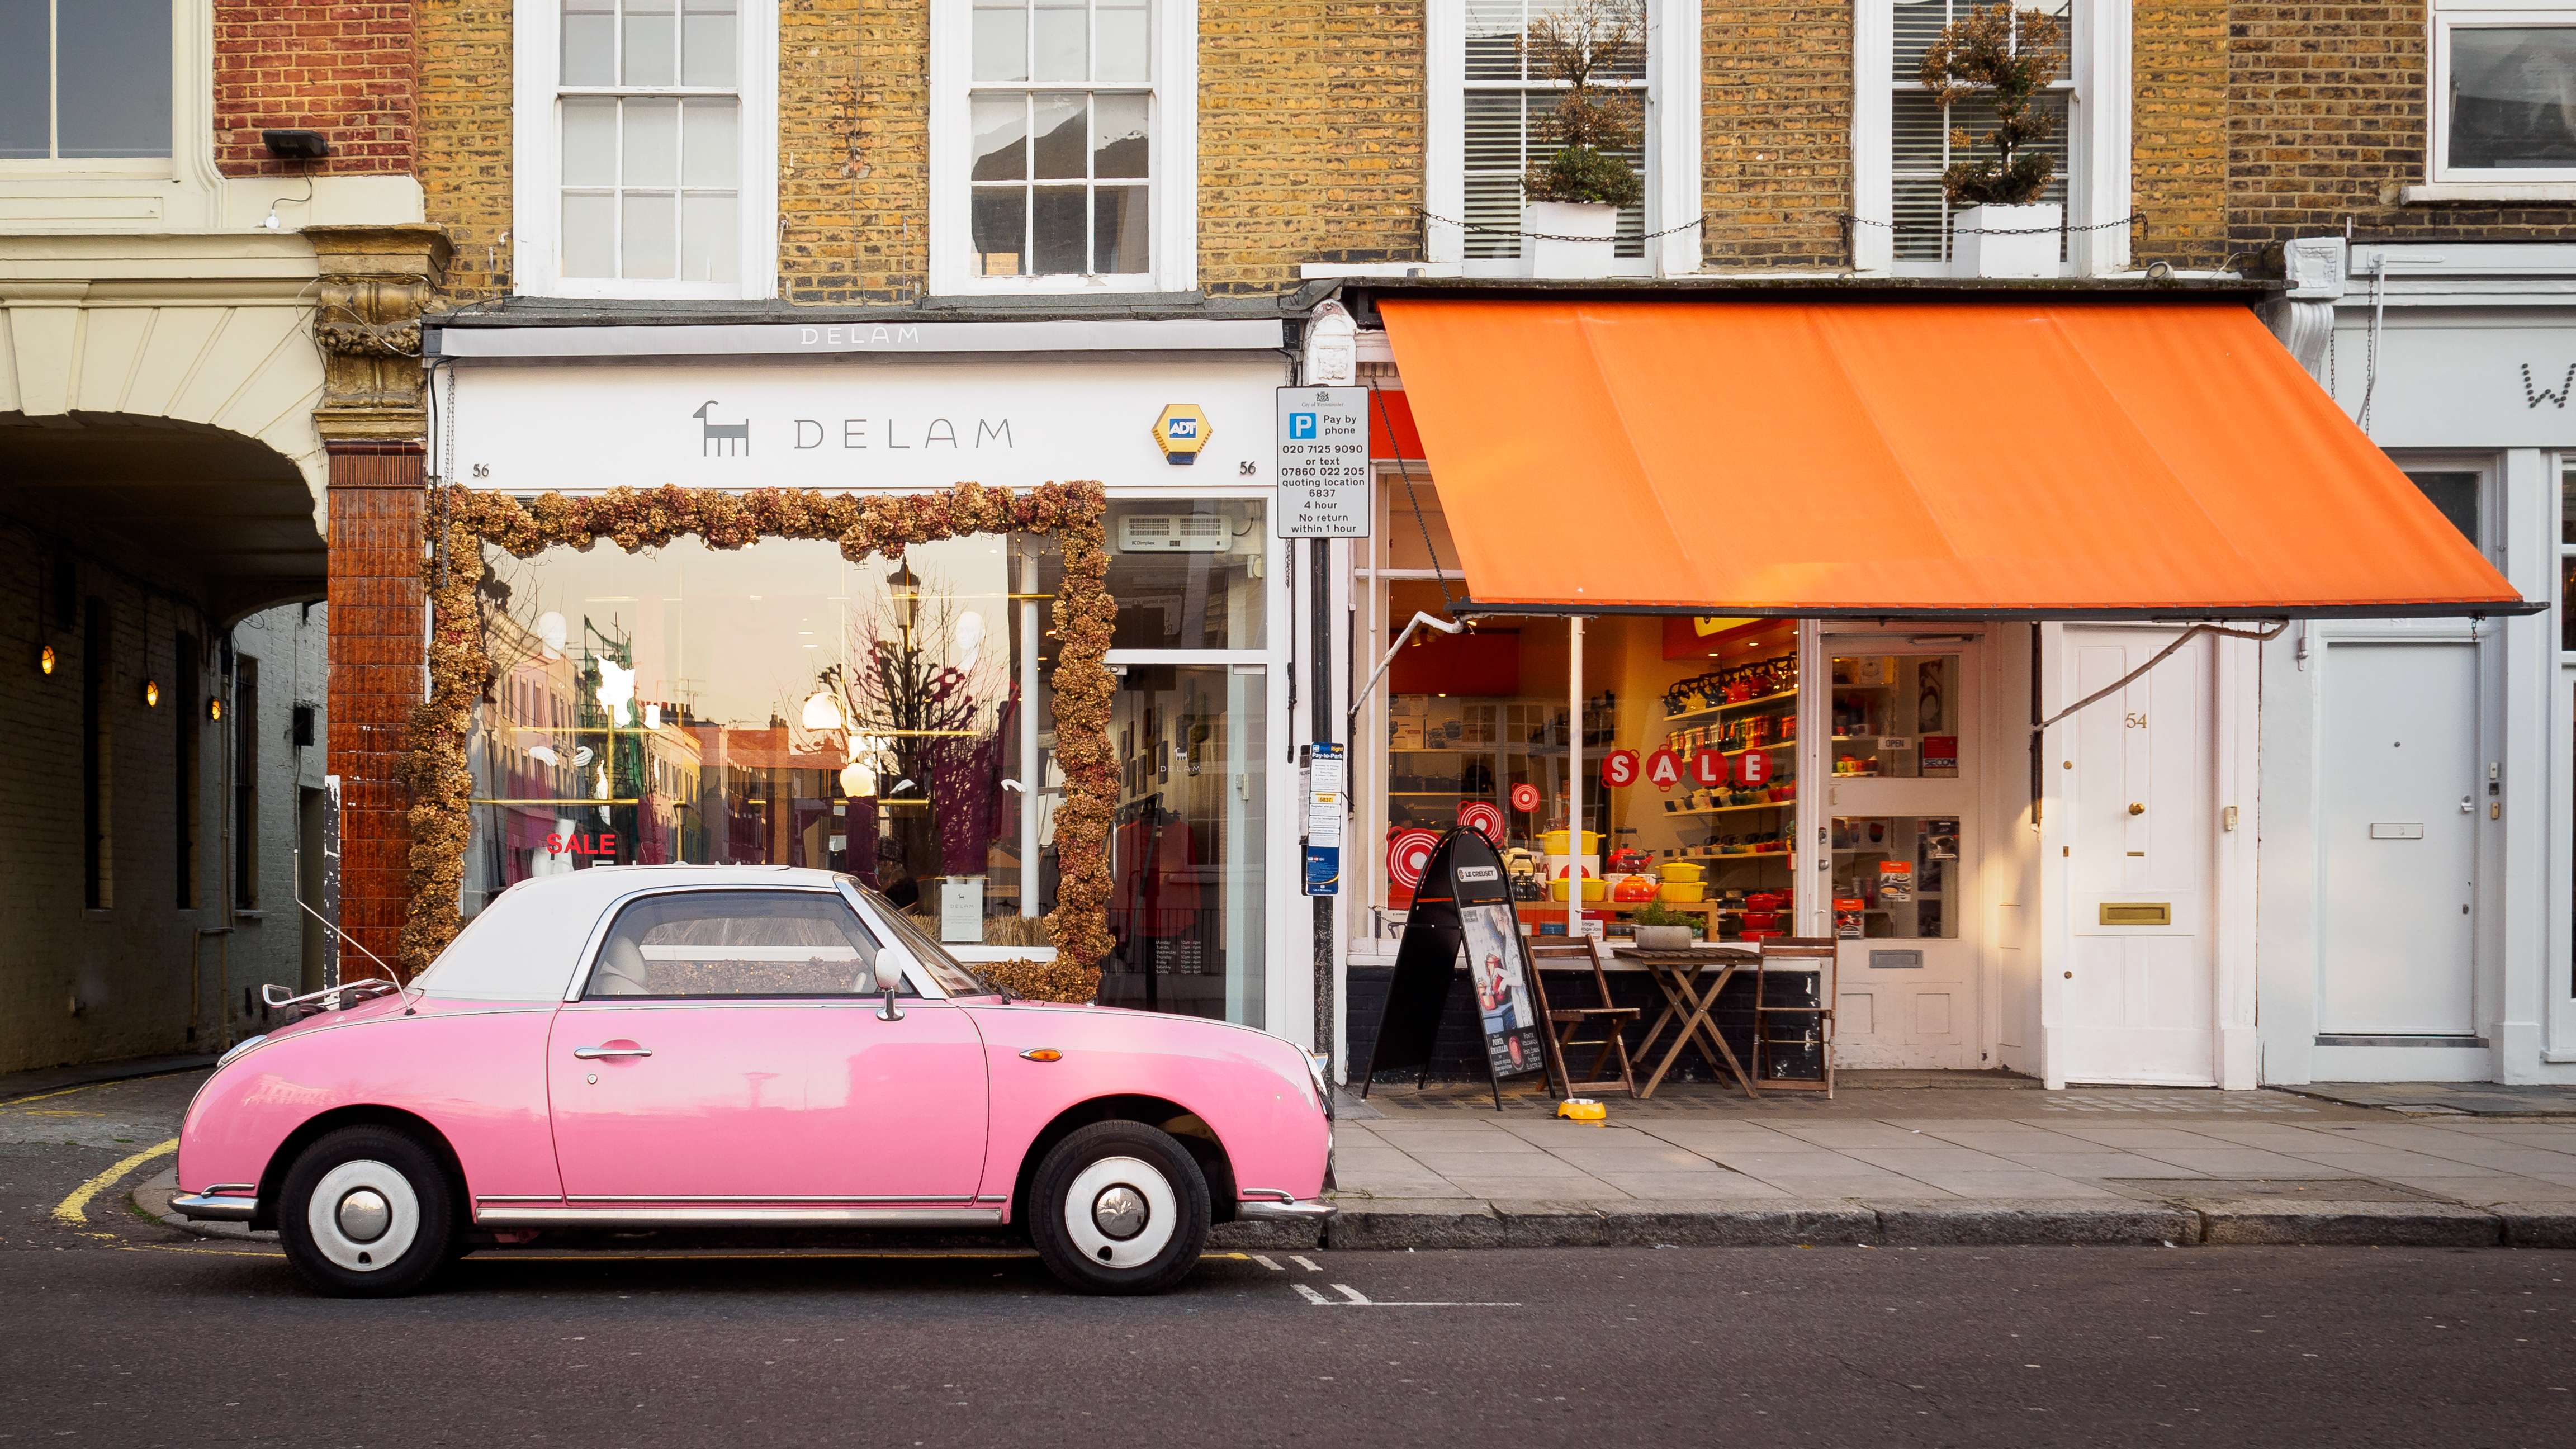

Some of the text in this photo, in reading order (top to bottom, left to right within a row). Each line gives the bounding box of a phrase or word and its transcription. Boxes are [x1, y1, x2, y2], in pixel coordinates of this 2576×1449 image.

[801, 326, 920, 345] DELAM
[2522, 363, 2576, 408] W
[1296, 415, 1313, 437] P
[1323, 415, 1357, 425] Pay by
[794, 418, 1012, 449] DELAM
[1169, 422, 1196, 435] ADT
[1325, 426, 1356, 436] phone
[1282, 445, 1363, 453] 020 7125 9090
[472, 463, 490, 479] 56
[1239, 461, 1256, 476] 56
[1281, 467, 1365, 476] 07860 022 205
[1282, 478, 1365, 487] quoting location
[1309, 489, 1336, 498] 6837
[1291, 524, 1322, 533] within
[2125, 712, 2147, 729] 54
[1886, 739, 1904, 747] OPEN
[1611, 755, 1761, 783] SALE
[547, 833, 616, 855] SALE
